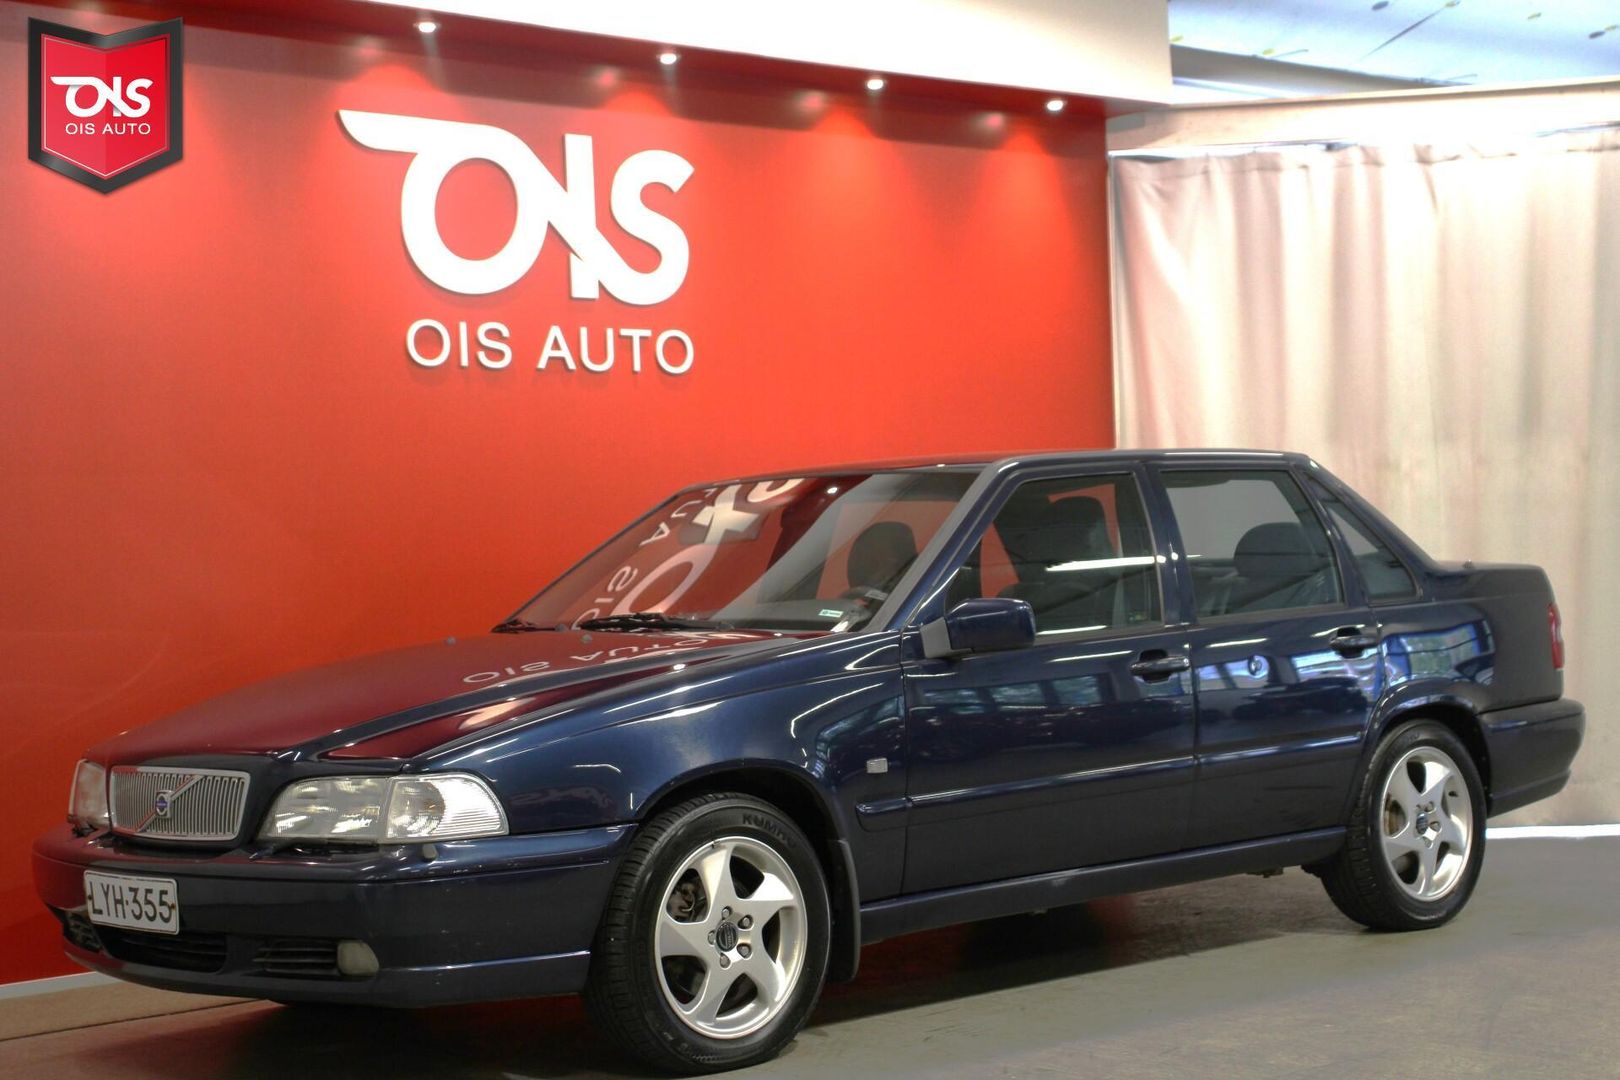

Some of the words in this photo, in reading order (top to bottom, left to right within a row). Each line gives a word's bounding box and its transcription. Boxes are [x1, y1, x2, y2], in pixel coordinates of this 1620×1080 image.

[338, 109, 695, 305] OIS
[406, 318, 512, 369] OIS
[537, 325, 694, 374] AUTO
[90, 881, 172, 923] LYH-355
